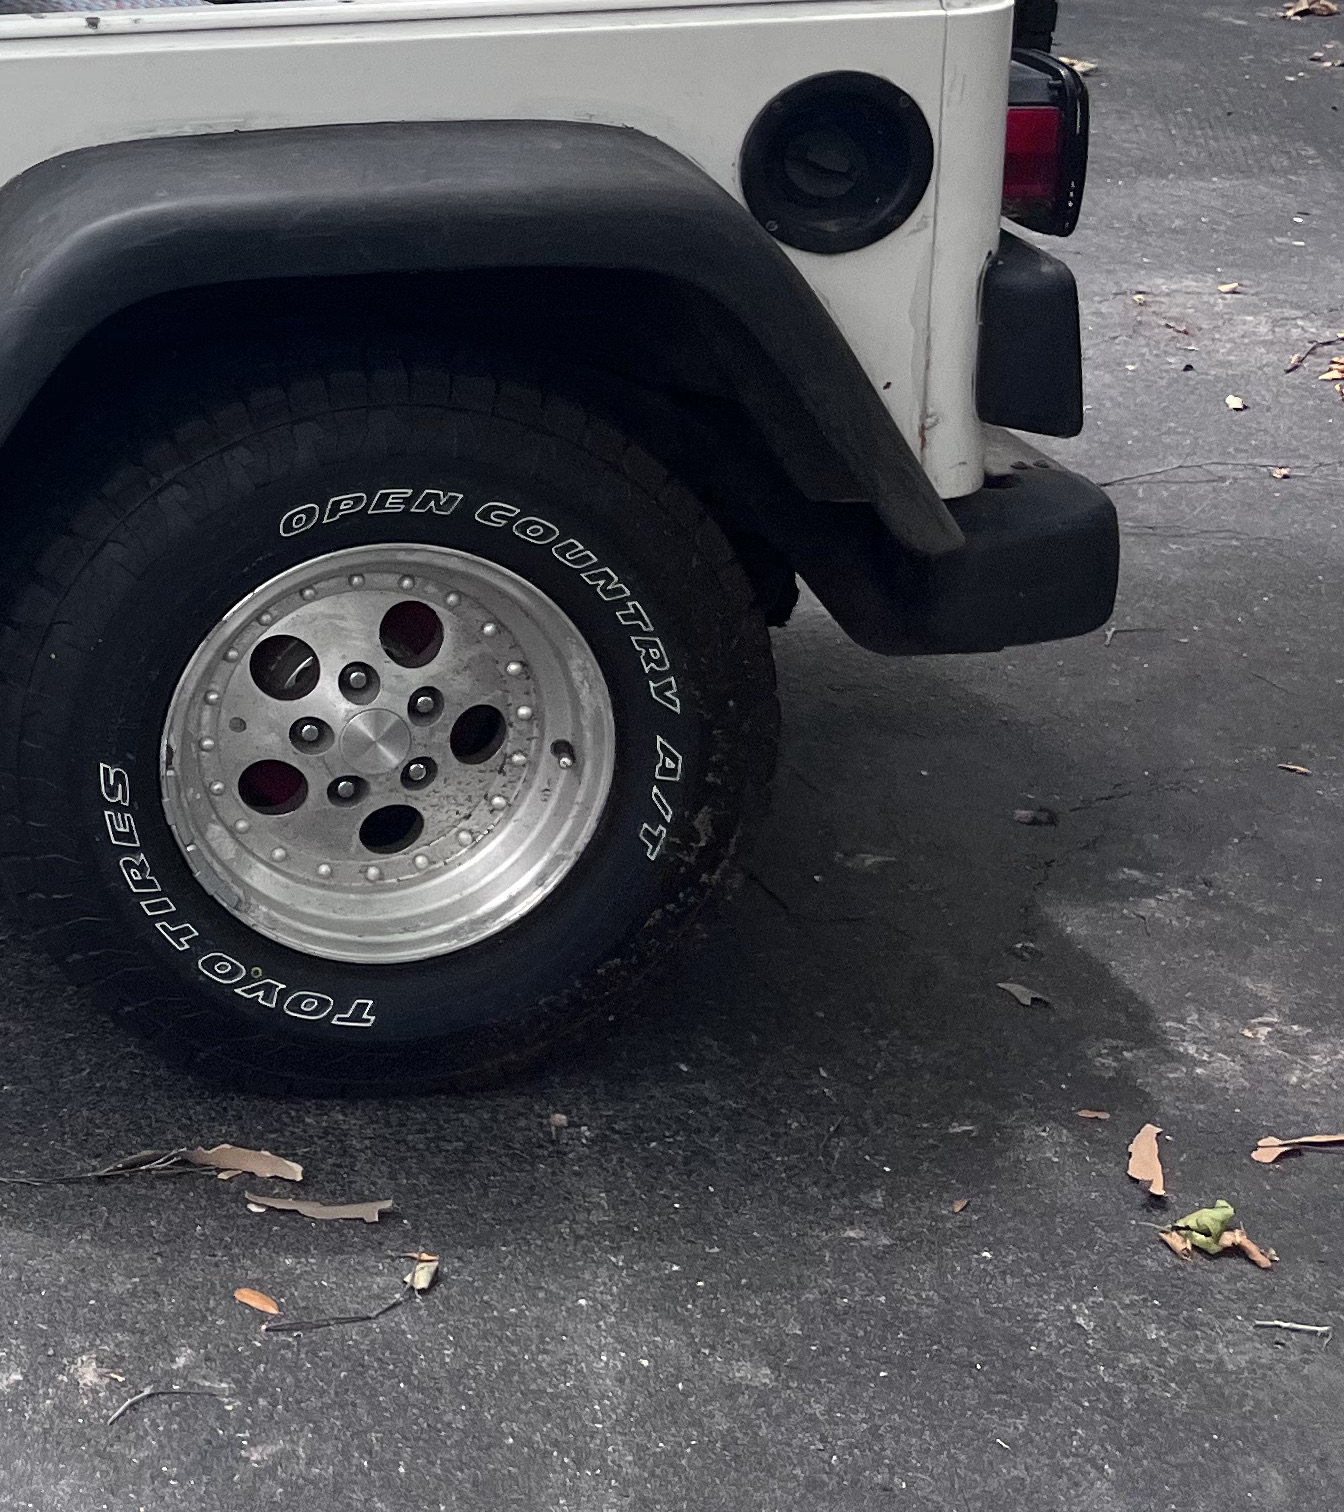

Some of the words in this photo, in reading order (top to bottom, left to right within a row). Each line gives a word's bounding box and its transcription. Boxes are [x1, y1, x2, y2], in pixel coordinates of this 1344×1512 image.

[279, 489, 463, 537] OPEN
[474, 501, 682, 714] COUNTRY
[638, 735, 683, 860] A/T
[99, 762, 199, 950] TIRES
[198, 952, 376, 1027] TOYO
